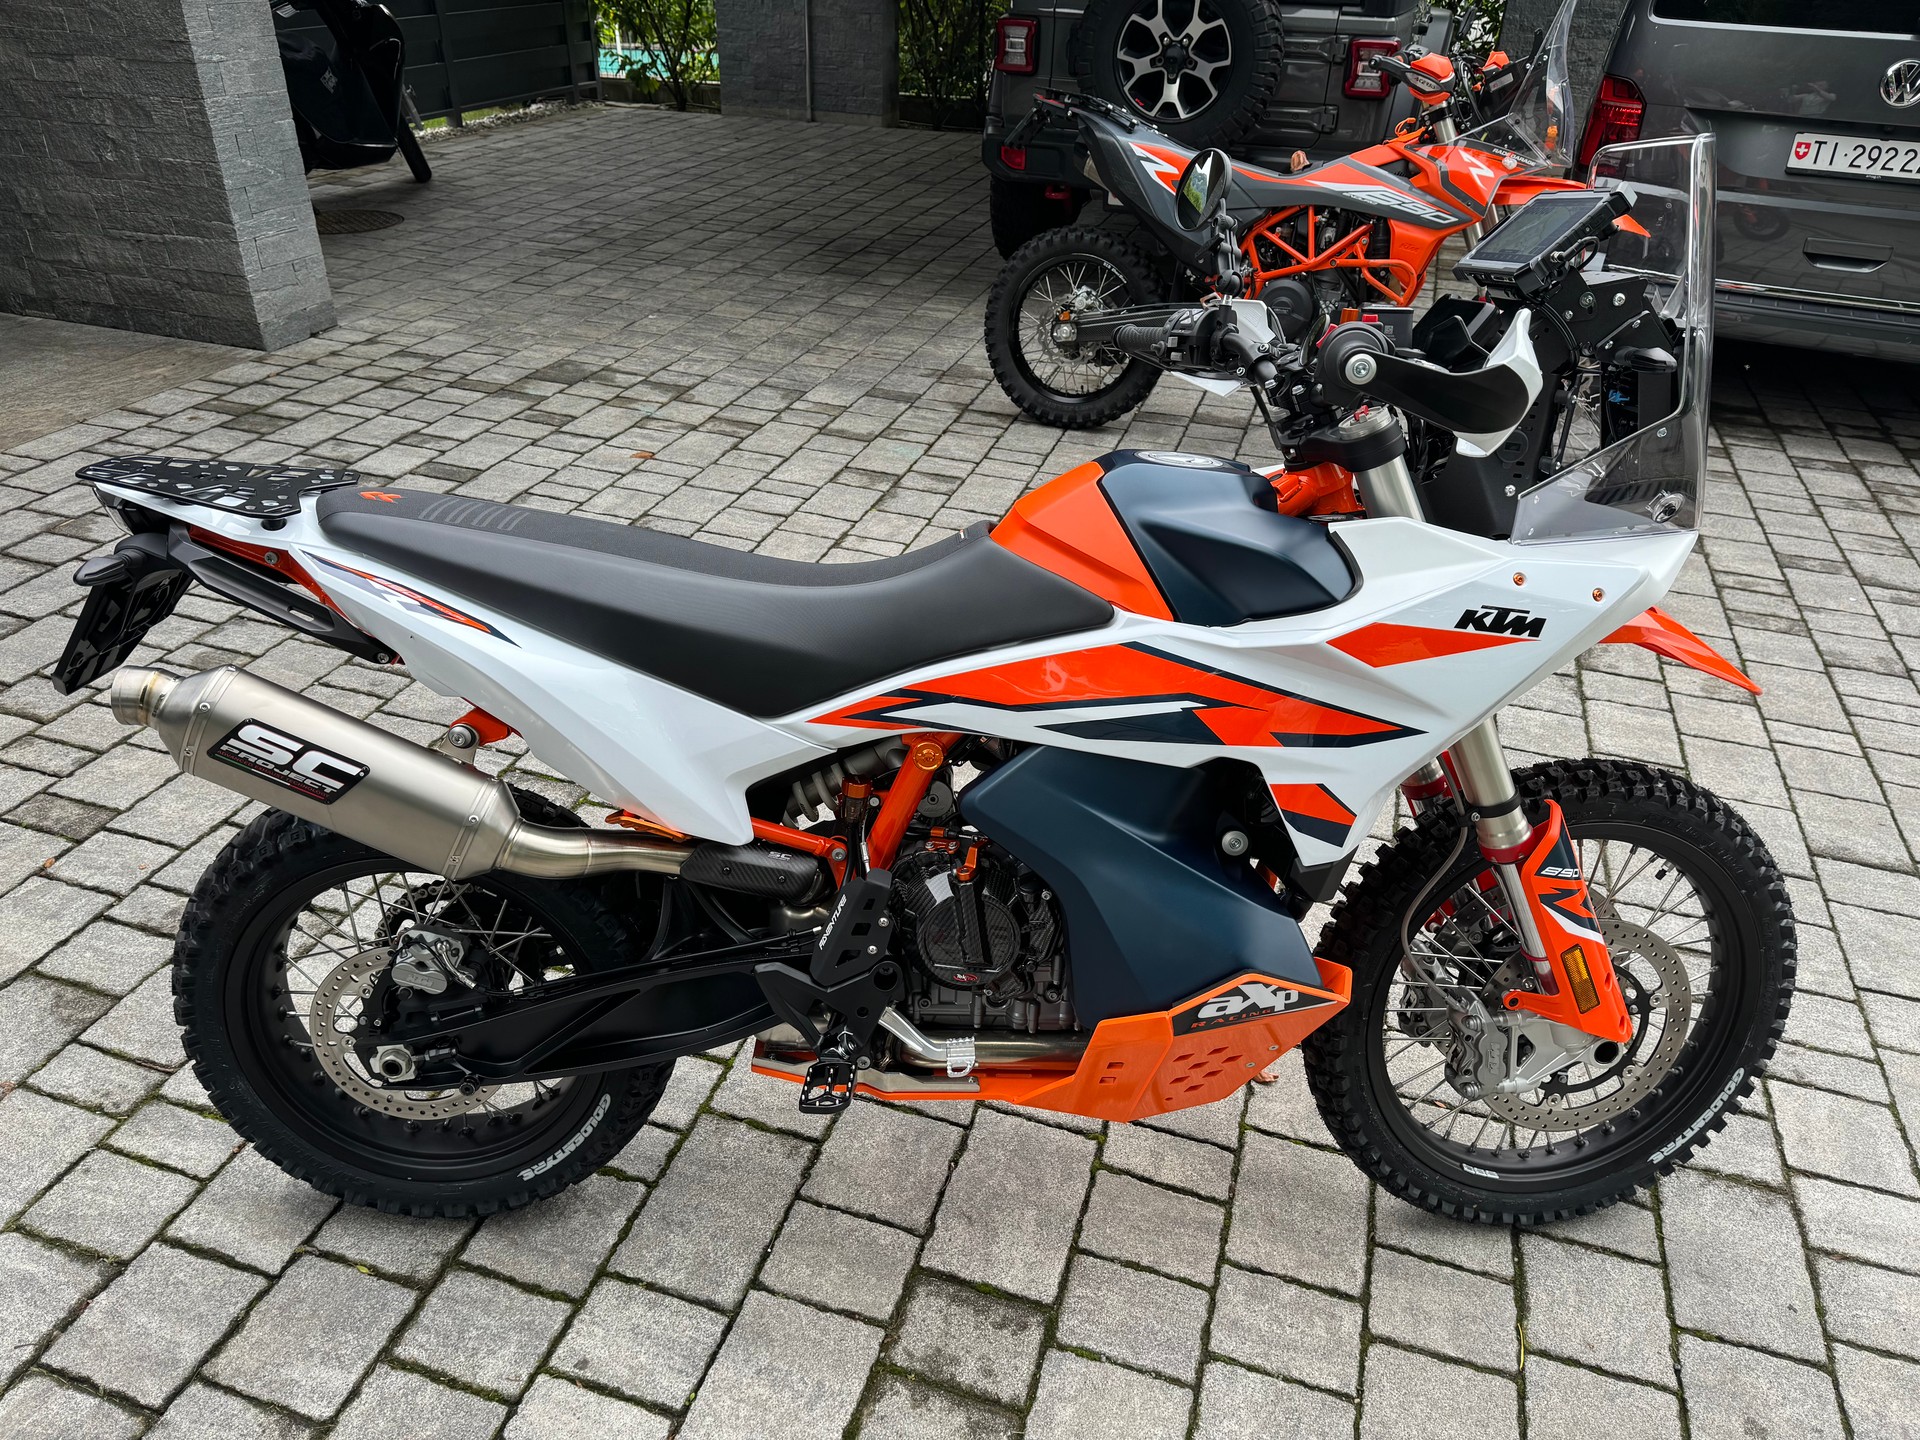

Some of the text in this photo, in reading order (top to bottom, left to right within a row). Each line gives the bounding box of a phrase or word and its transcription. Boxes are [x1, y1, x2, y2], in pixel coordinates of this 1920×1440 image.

[1454, 604, 1547, 638] KTM
[217, 750, 254, 767] ADVANCED
[220, 744, 337, 793] PROJECT
[226, 724, 364, 789] SC
[1540, 866, 1580, 878] 890
[818, 894, 847, 950] ADVENTURE
[1190, 1008, 1272, 1029] RACING
[517, 1093, 611, 1181] GOLDENTYRE
[1647, 1067, 1745, 1164] GOLDENTYRE
